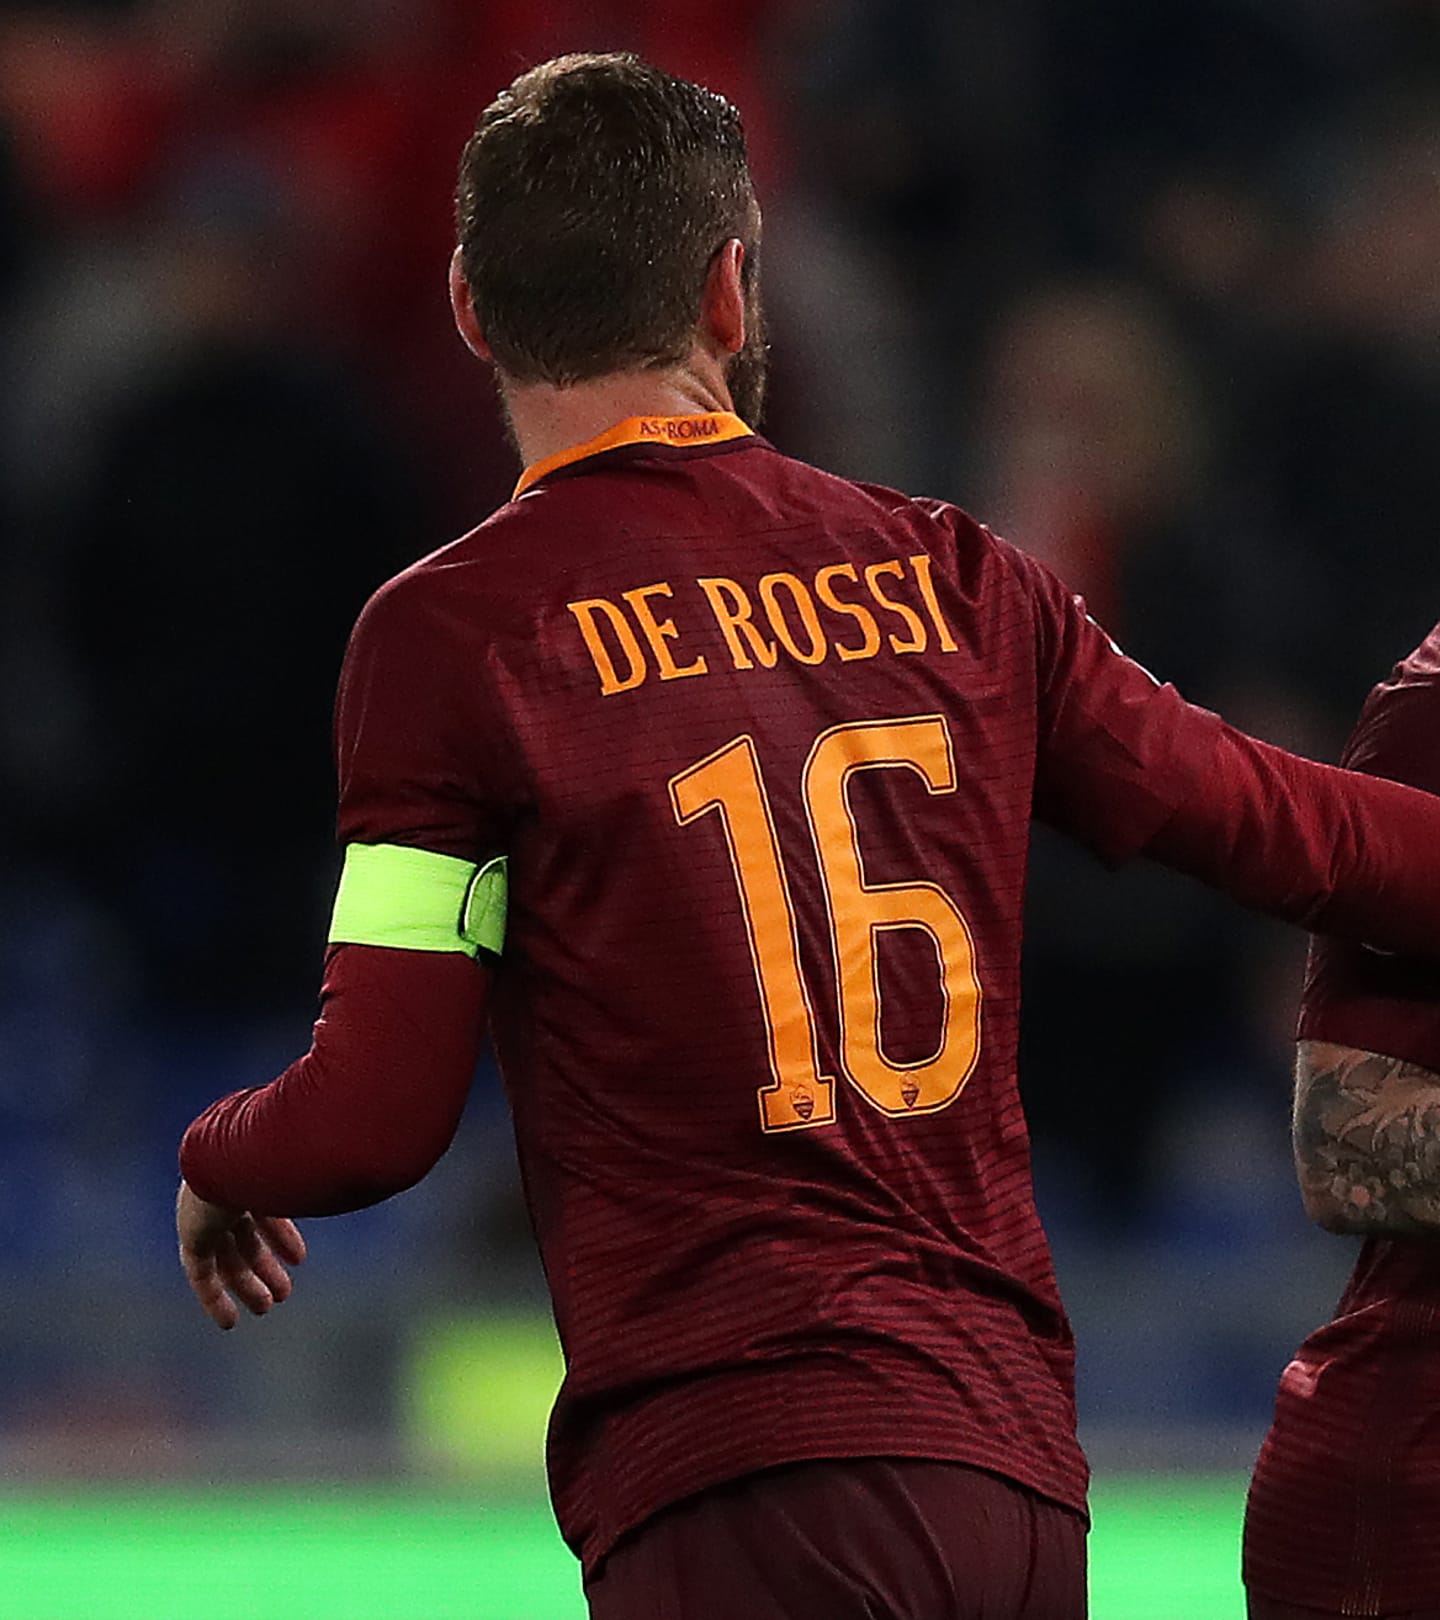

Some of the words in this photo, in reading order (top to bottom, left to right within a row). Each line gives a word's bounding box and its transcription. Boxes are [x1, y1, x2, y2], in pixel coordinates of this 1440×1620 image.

[567, 582, 708, 697] DE
[697, 555, 959, 669] ROSSI
[668, 714, 982, 1133] 16
